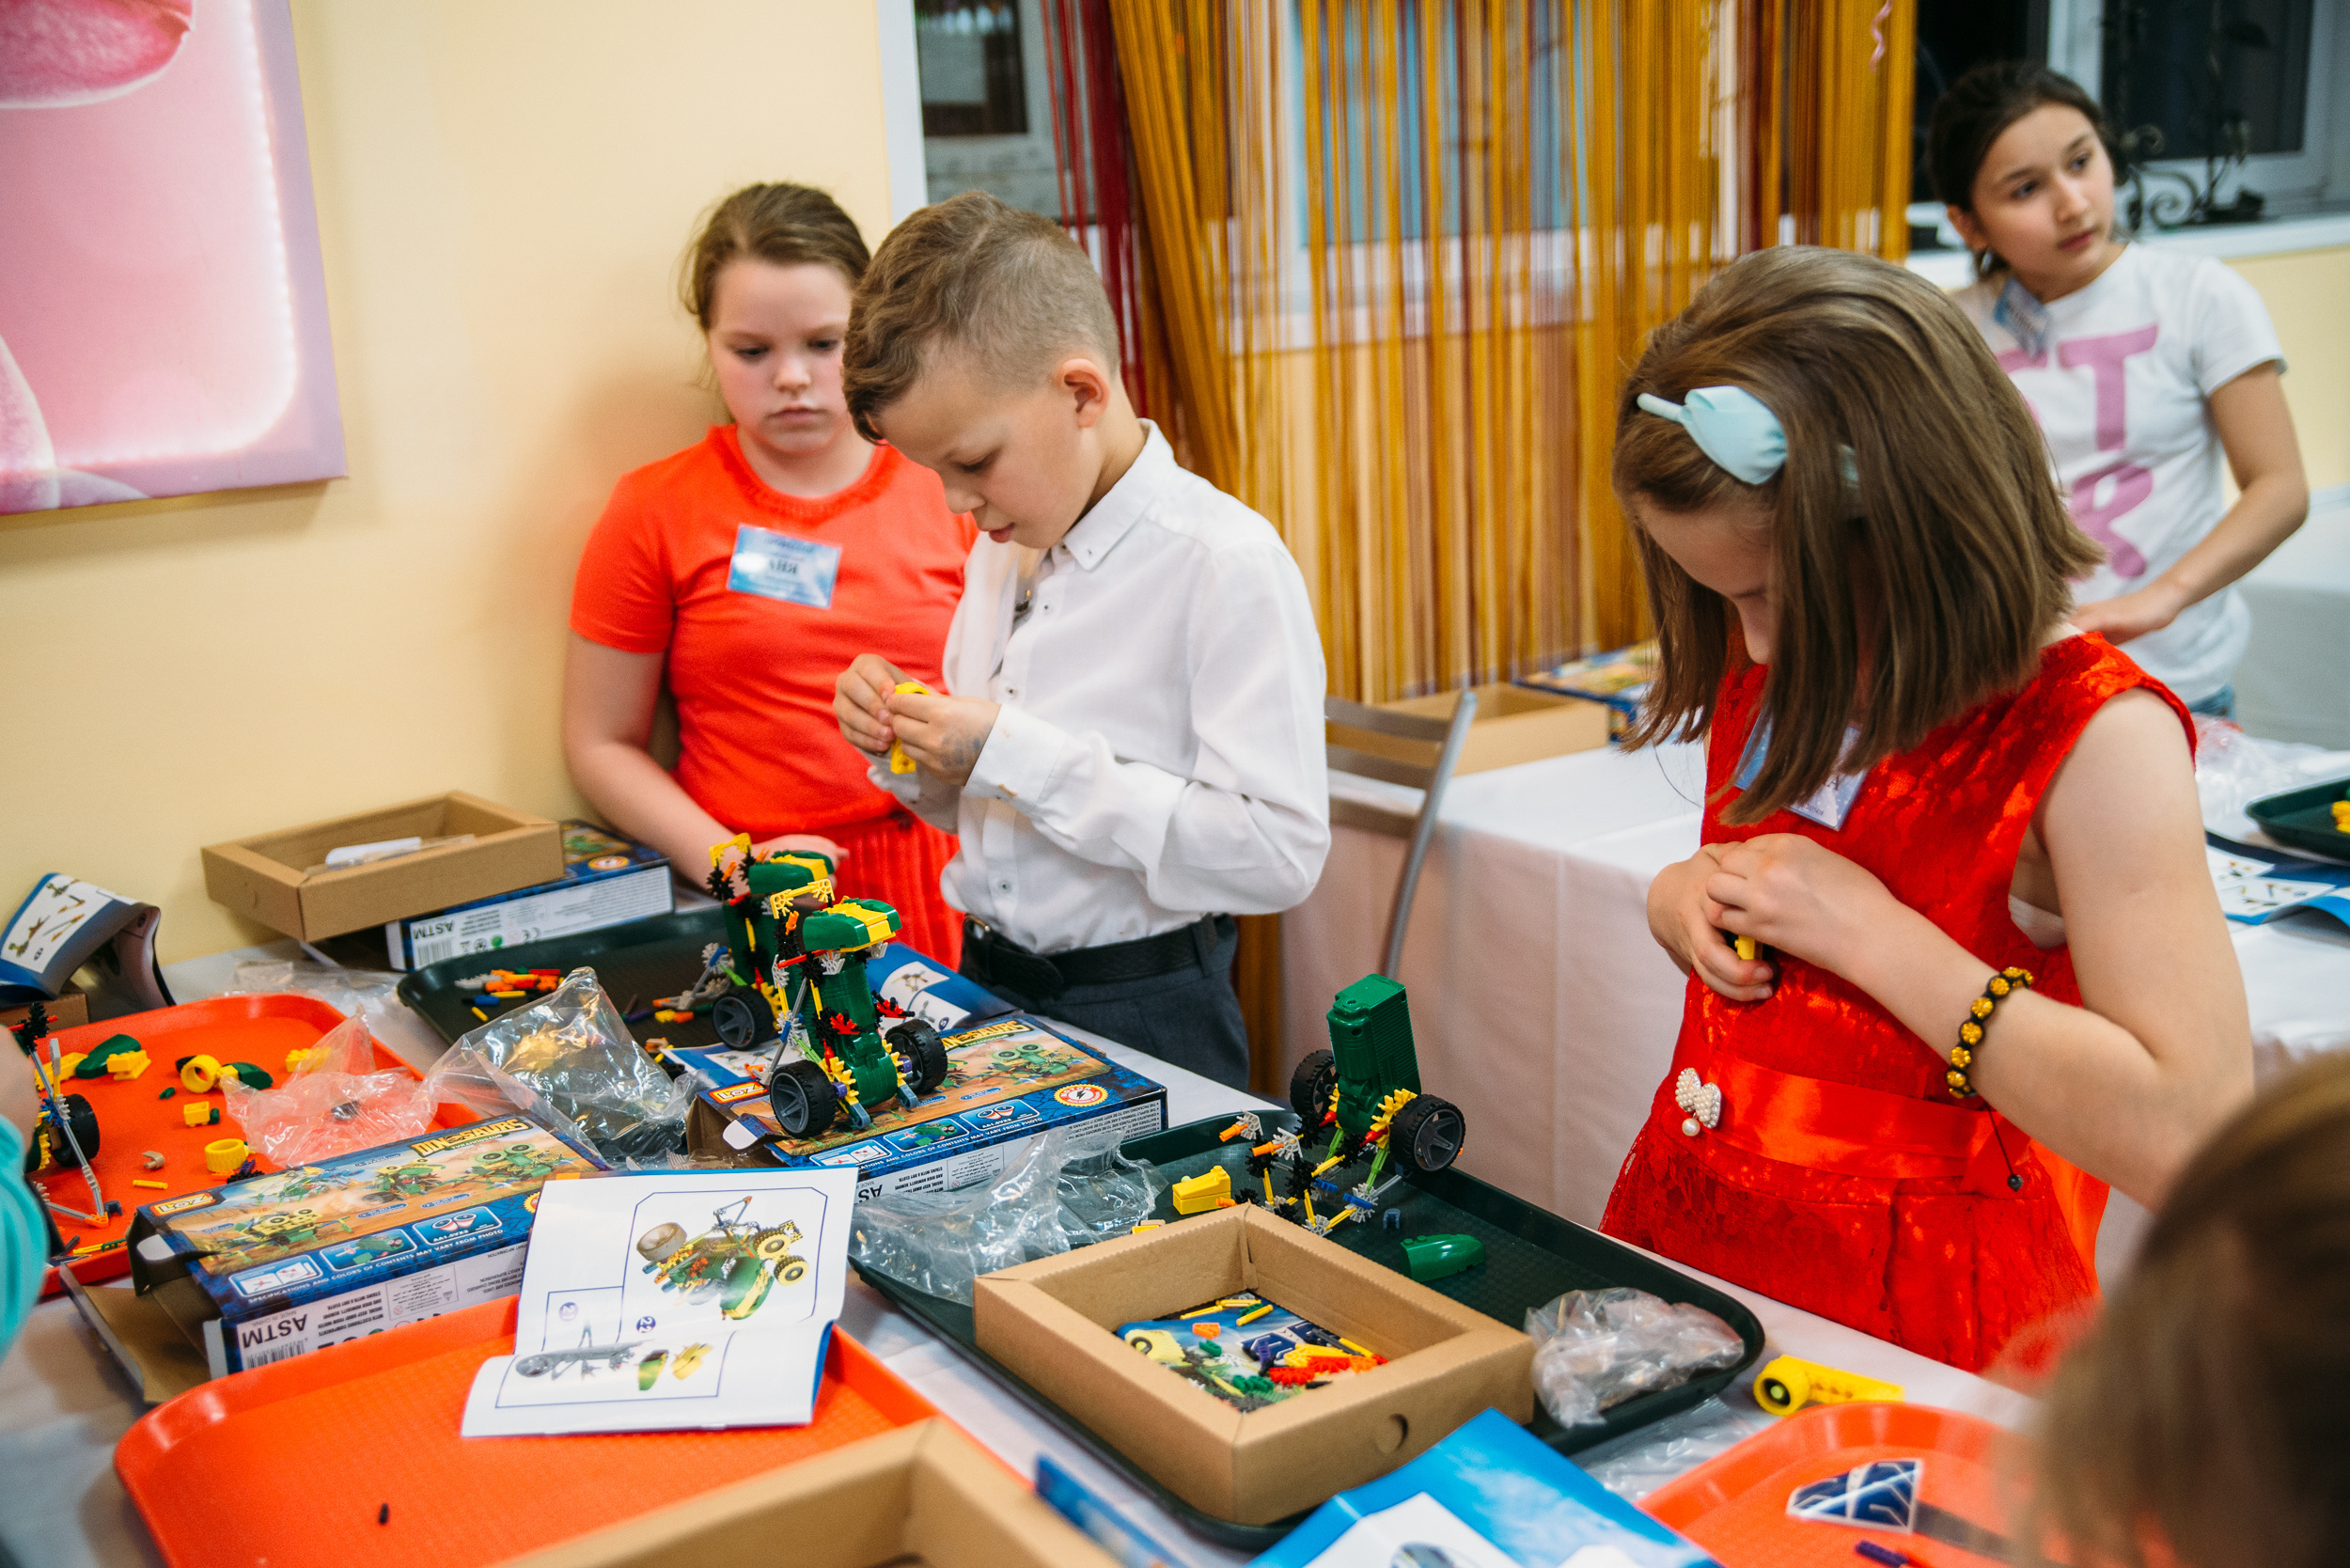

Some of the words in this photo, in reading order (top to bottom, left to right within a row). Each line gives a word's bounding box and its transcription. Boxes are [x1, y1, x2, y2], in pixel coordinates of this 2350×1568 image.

[413, 920, 454, 940] ASTM
[941, 1020, 1030, 1051] INOSAURS
[717, 1085, 765, 1100] LOZ
[411, 1118, 529, 1157] DINOSAURS
[860, 1161, 884, 1170] ATIONS
[901, 1149, 926, 1158] COLORS
[937, 1137, 969, 1149] CONTENTS
[970, 1132, 984, 1140] MAY
[1002, 1123, 1021, 1132] FROM
[158, 1194, 213, 1213] LOZ
[248, 1283, 310, 1304] SPECIFICATIONS
[312, 1278, 329, 1286] AND
[331, 1269, 362, 1280] COLORS
[376, 1254, 415, 1268] CONTENTS
[416, 1247, 432, 1258] MAY
[434, 1243, 453, 1254] VARY
[455, 1237, 477, 1247] FROM
[243, 1314, 308, 1348] ASTM
[639, 1316, 653, 1333] 22
